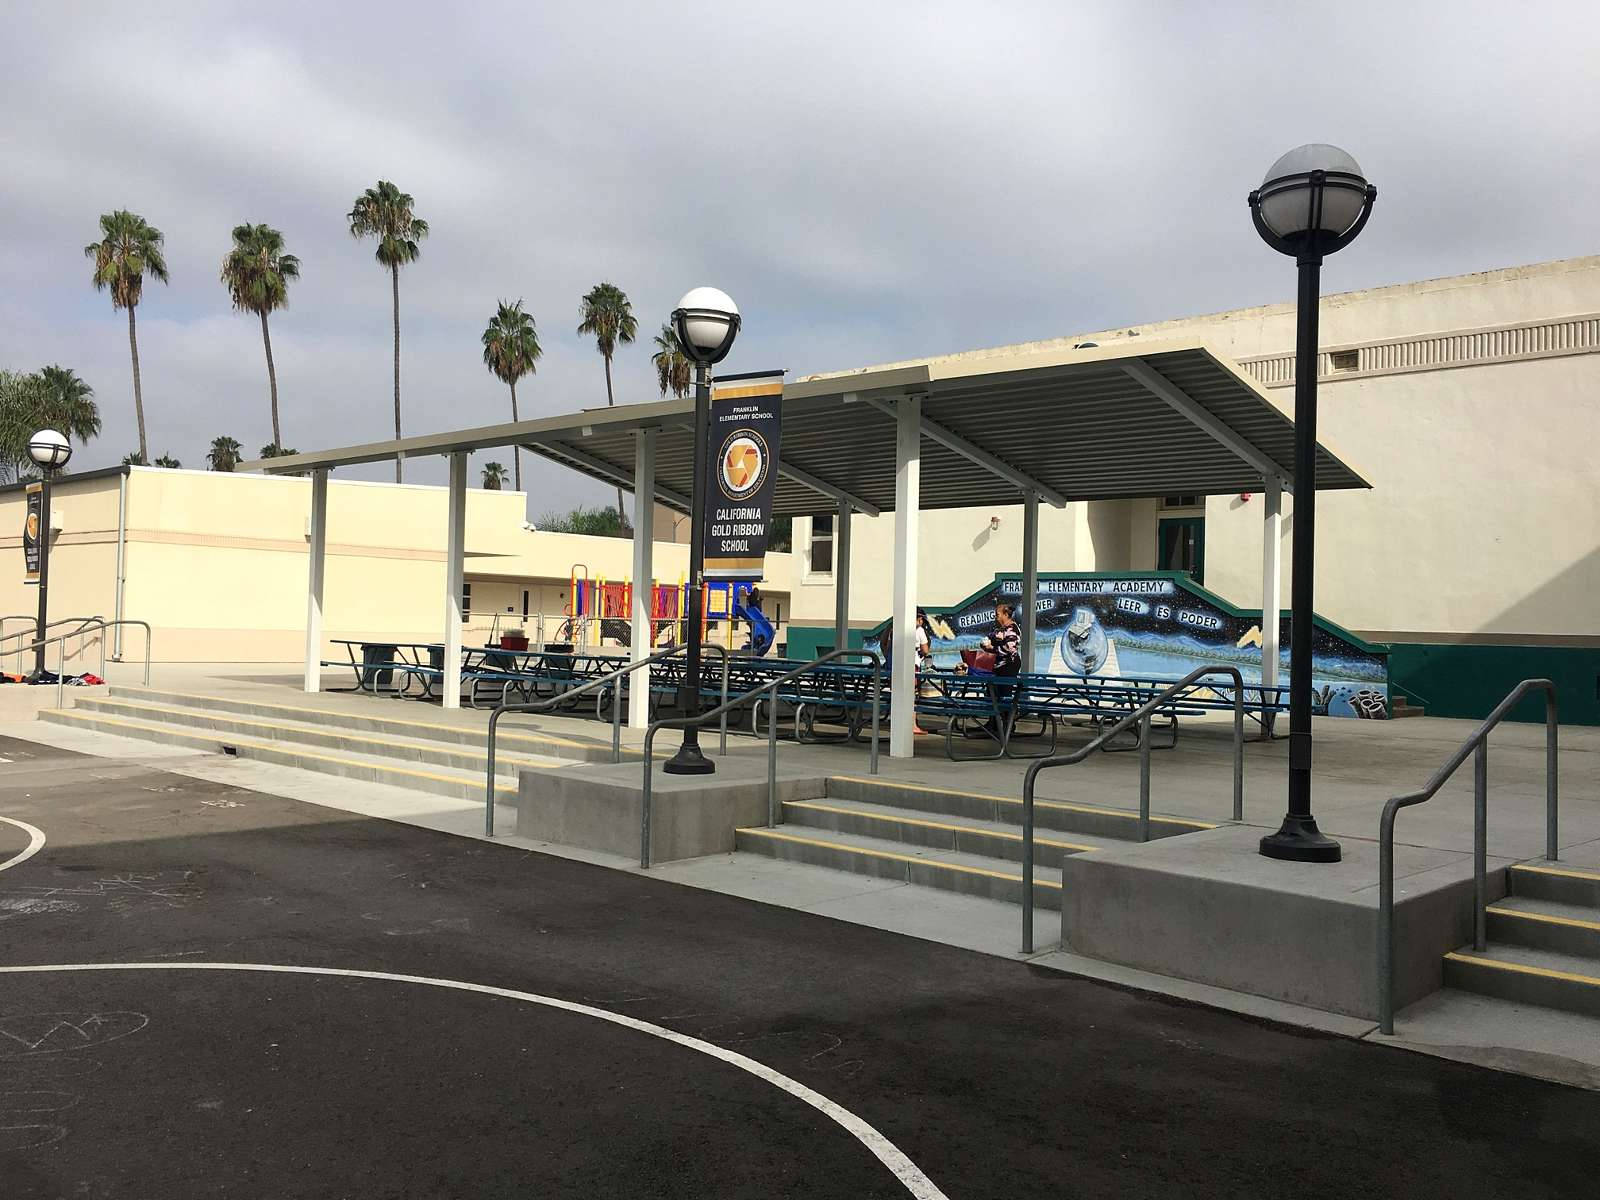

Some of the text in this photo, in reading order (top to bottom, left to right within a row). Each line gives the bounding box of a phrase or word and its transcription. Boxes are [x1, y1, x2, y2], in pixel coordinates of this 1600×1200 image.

[732, 405, 759, 414] FRANKLIN
[719, 412, 774, 422] ELEMENTARY SCHOOL
[716, 507, 761, 521] CALIFORNIA
[712, 523, 765, 537] GOLD RIBBON
[720, 539, 750, 552] SCHOOL
[1048, 581, 1104, 592] ELEMENTARY
[1112, 581, 1165, 592] ACADEMY
[960, 610, 996, 627] READING
[1118, 598, 1218, 628] LEER ES PODER
